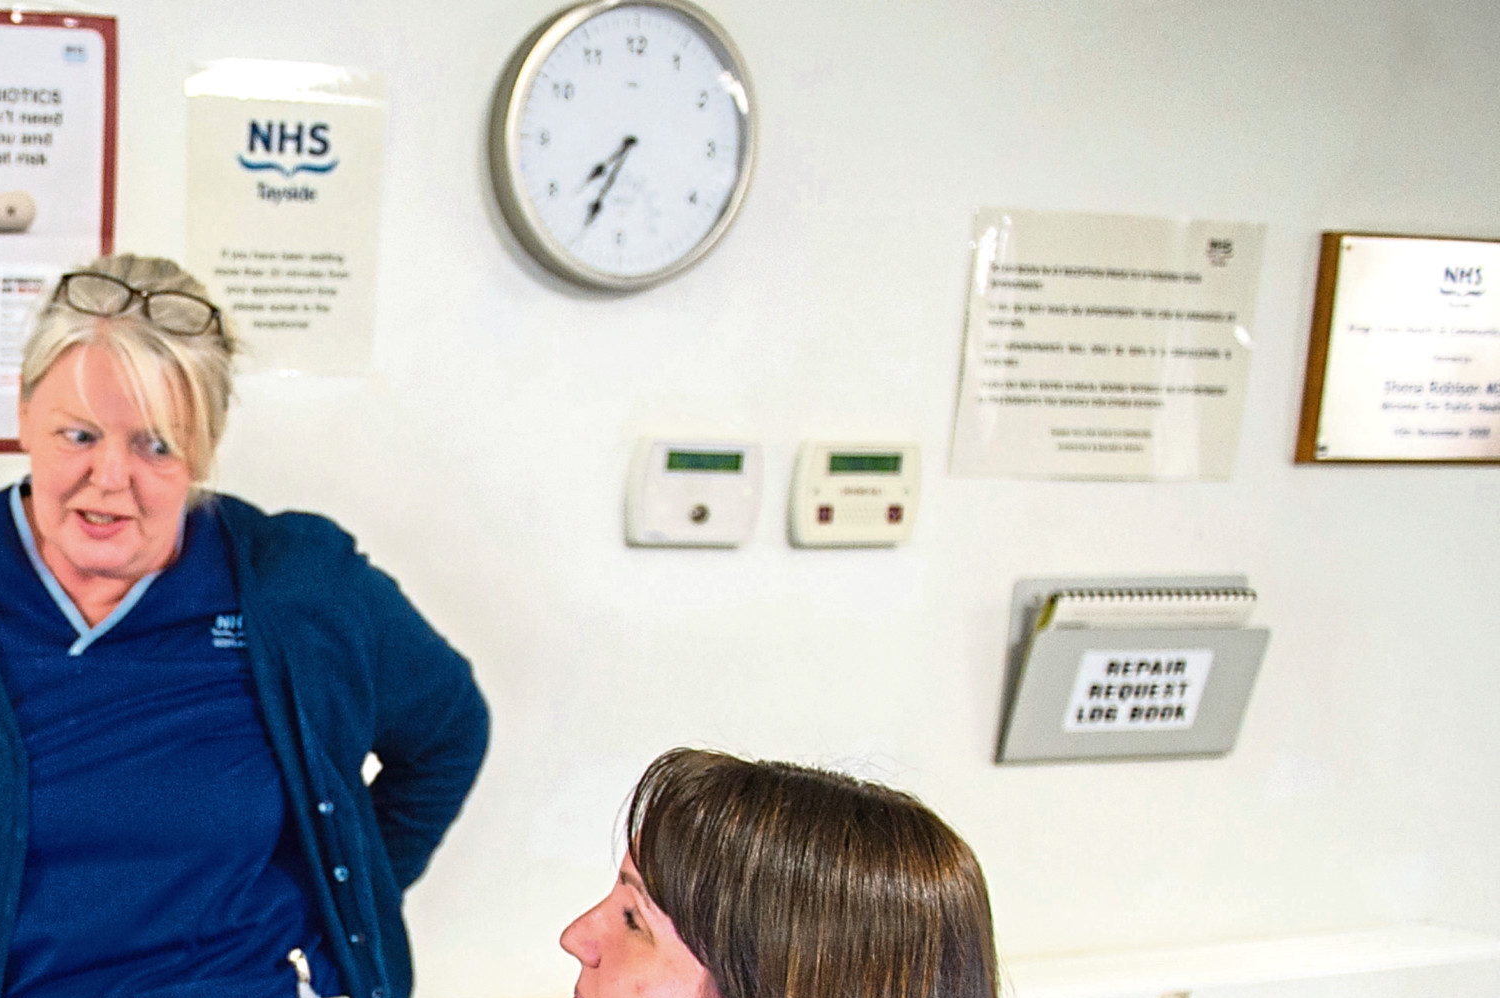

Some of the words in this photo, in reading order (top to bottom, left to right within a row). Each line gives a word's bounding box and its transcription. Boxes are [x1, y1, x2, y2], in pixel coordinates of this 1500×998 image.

[626, 36, 648, 57] 12
[583, 48, 602, 65] 11
[552, 82, 575, 101] 10
[20, 111, 63, 126] need
[21, 131, 53, 147] and
[248, 118, 331, 156] NHS
[17, 152, 47, 167] risk
[256, 181, 318, 205] Tayside
[1444, 266, 1484, 285] NHS
[1105, 659, 1188, 676] REPAIR
[1087, 682, 1189, 700] REQUEST
[1074, 706, 1119, 723] LOG
[1127, 705, 1187, 722] BOOK
